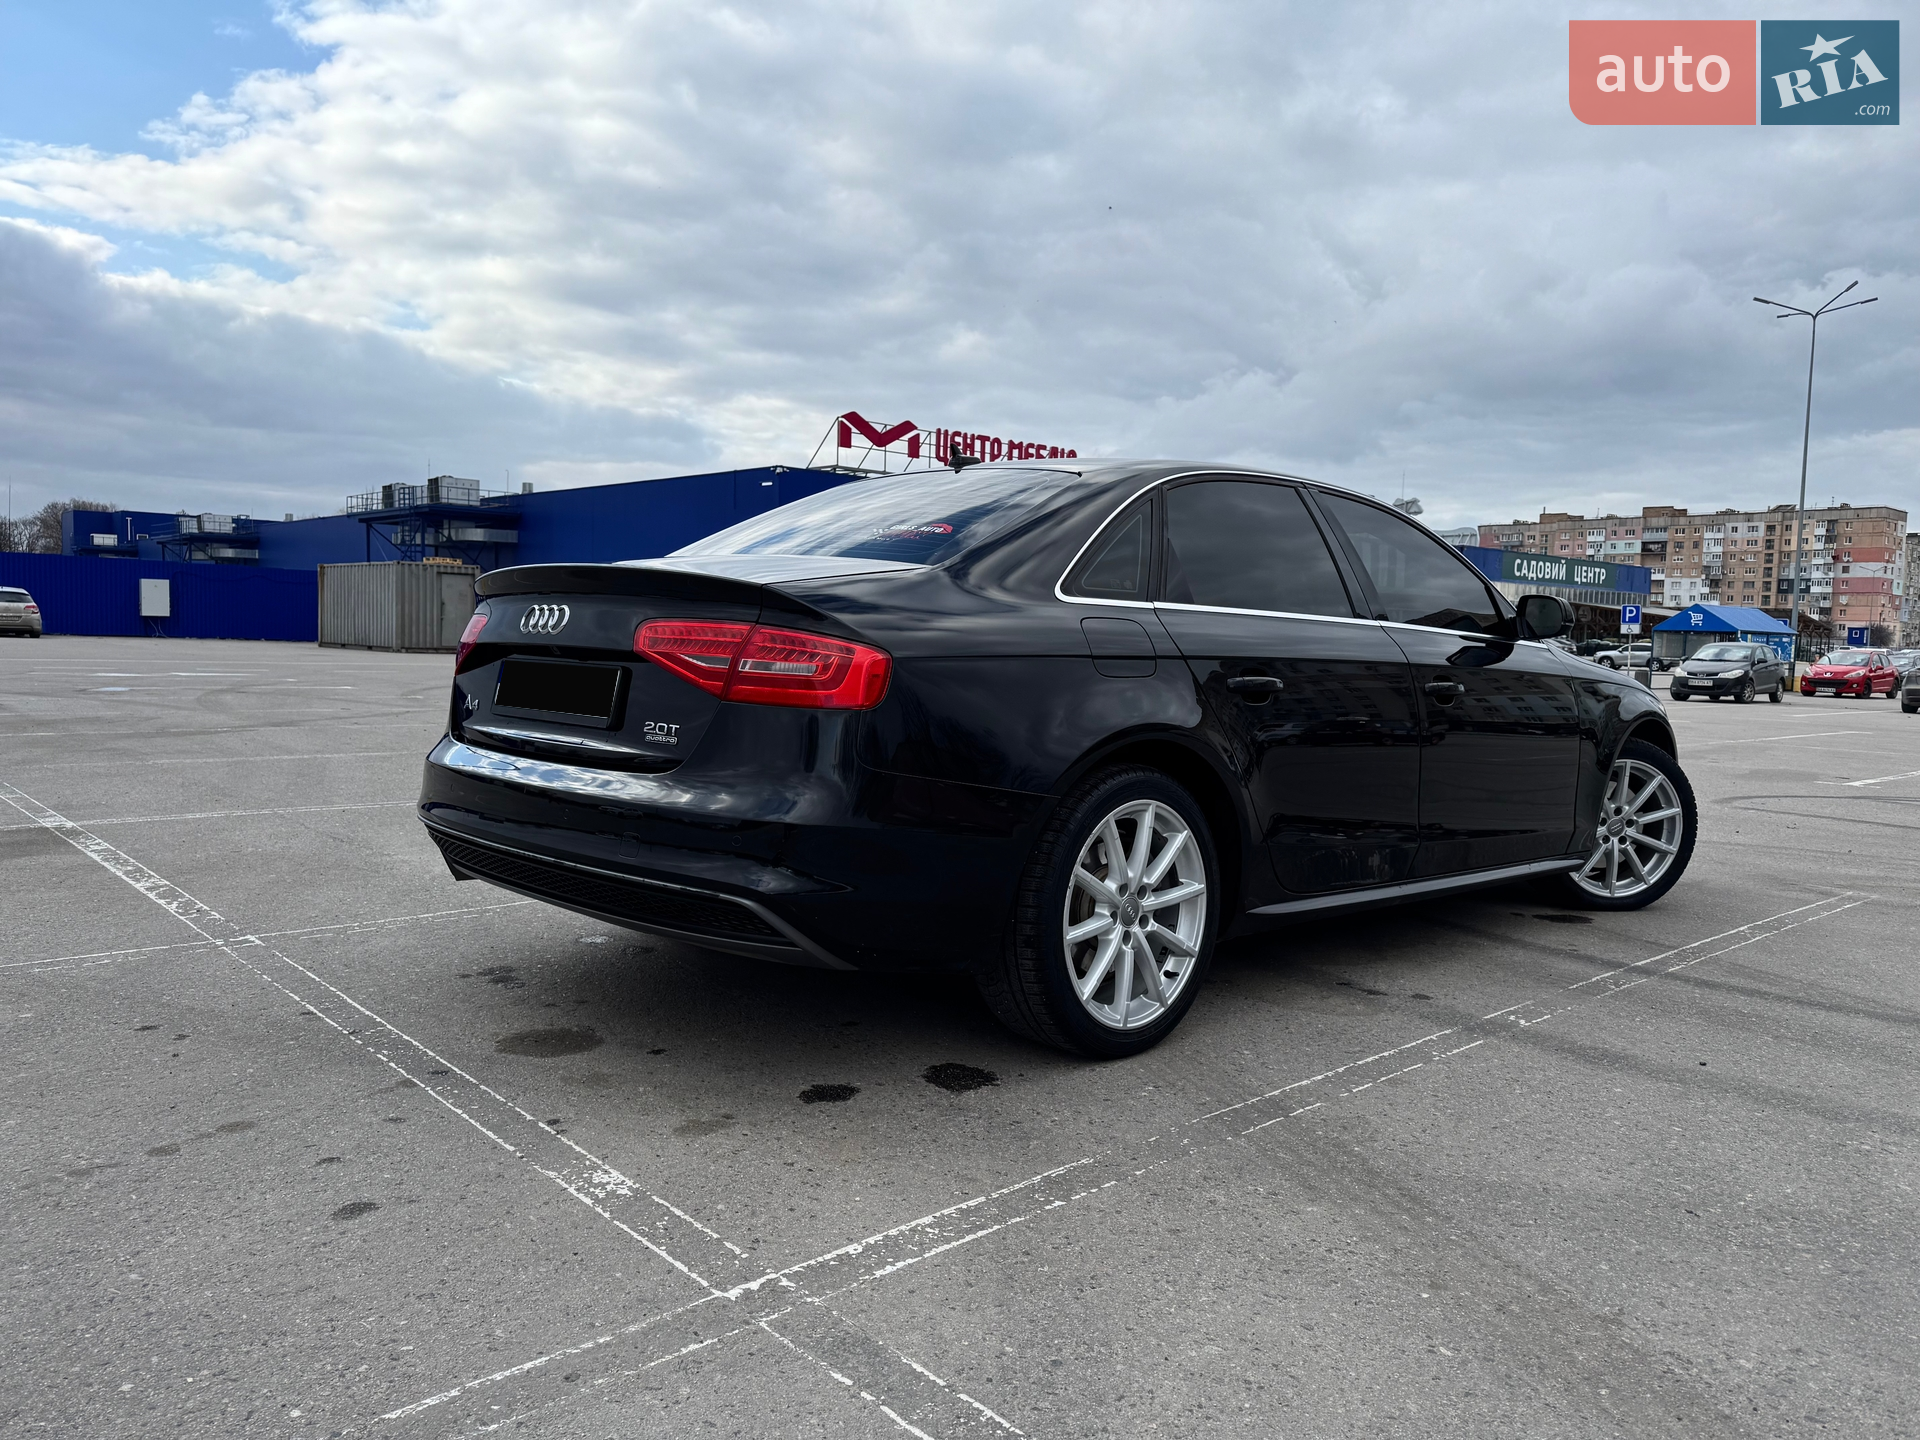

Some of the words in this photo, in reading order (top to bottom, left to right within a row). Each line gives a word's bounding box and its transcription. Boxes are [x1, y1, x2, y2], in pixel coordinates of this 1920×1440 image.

[1513, 558, 1567, 581] САДОВИЙ
[1573, 564, 1607, 585] ЦЕНТР
[1625, 606, 1637, 622] P
[463, 693, 479, 711] A4
